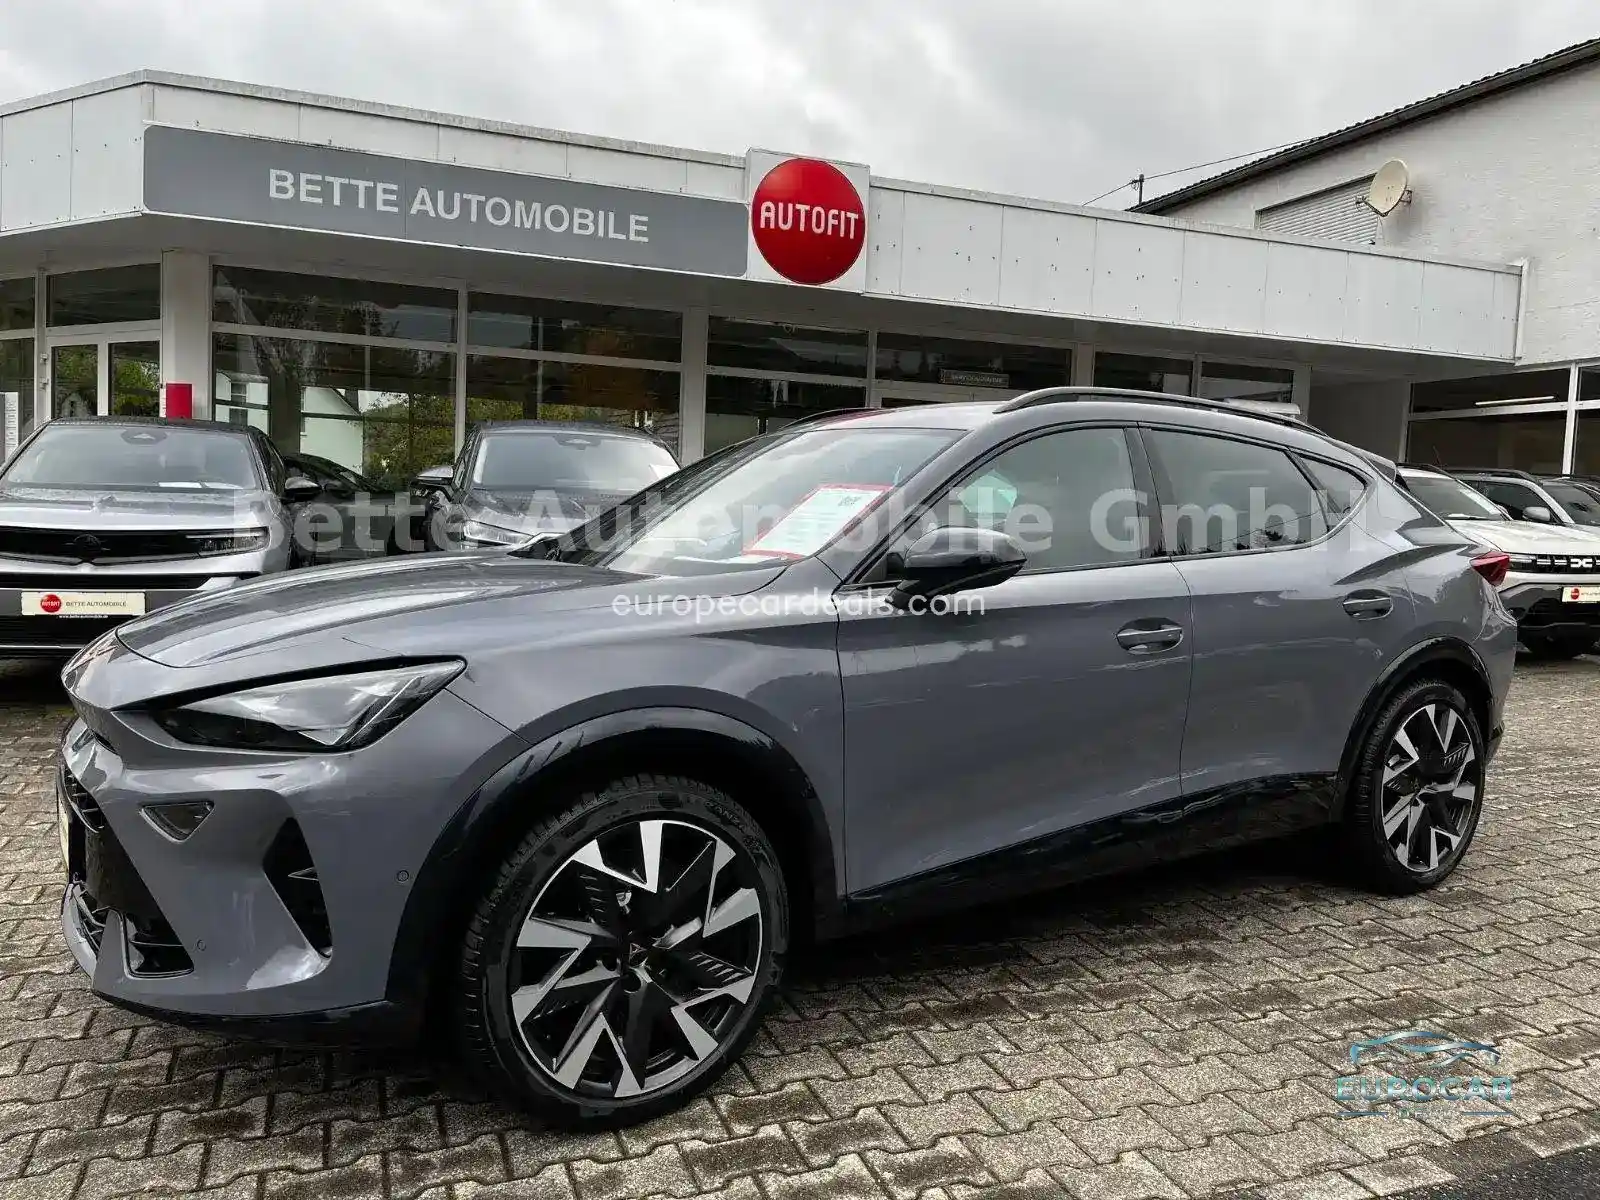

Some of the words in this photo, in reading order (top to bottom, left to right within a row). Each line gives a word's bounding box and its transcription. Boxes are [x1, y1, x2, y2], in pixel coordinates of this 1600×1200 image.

[269, 168, 399, 213] BETTE
[409, 187, 649, 243] AUTOMOBILE
[760, 200, 859, 240] AUTOFIT
